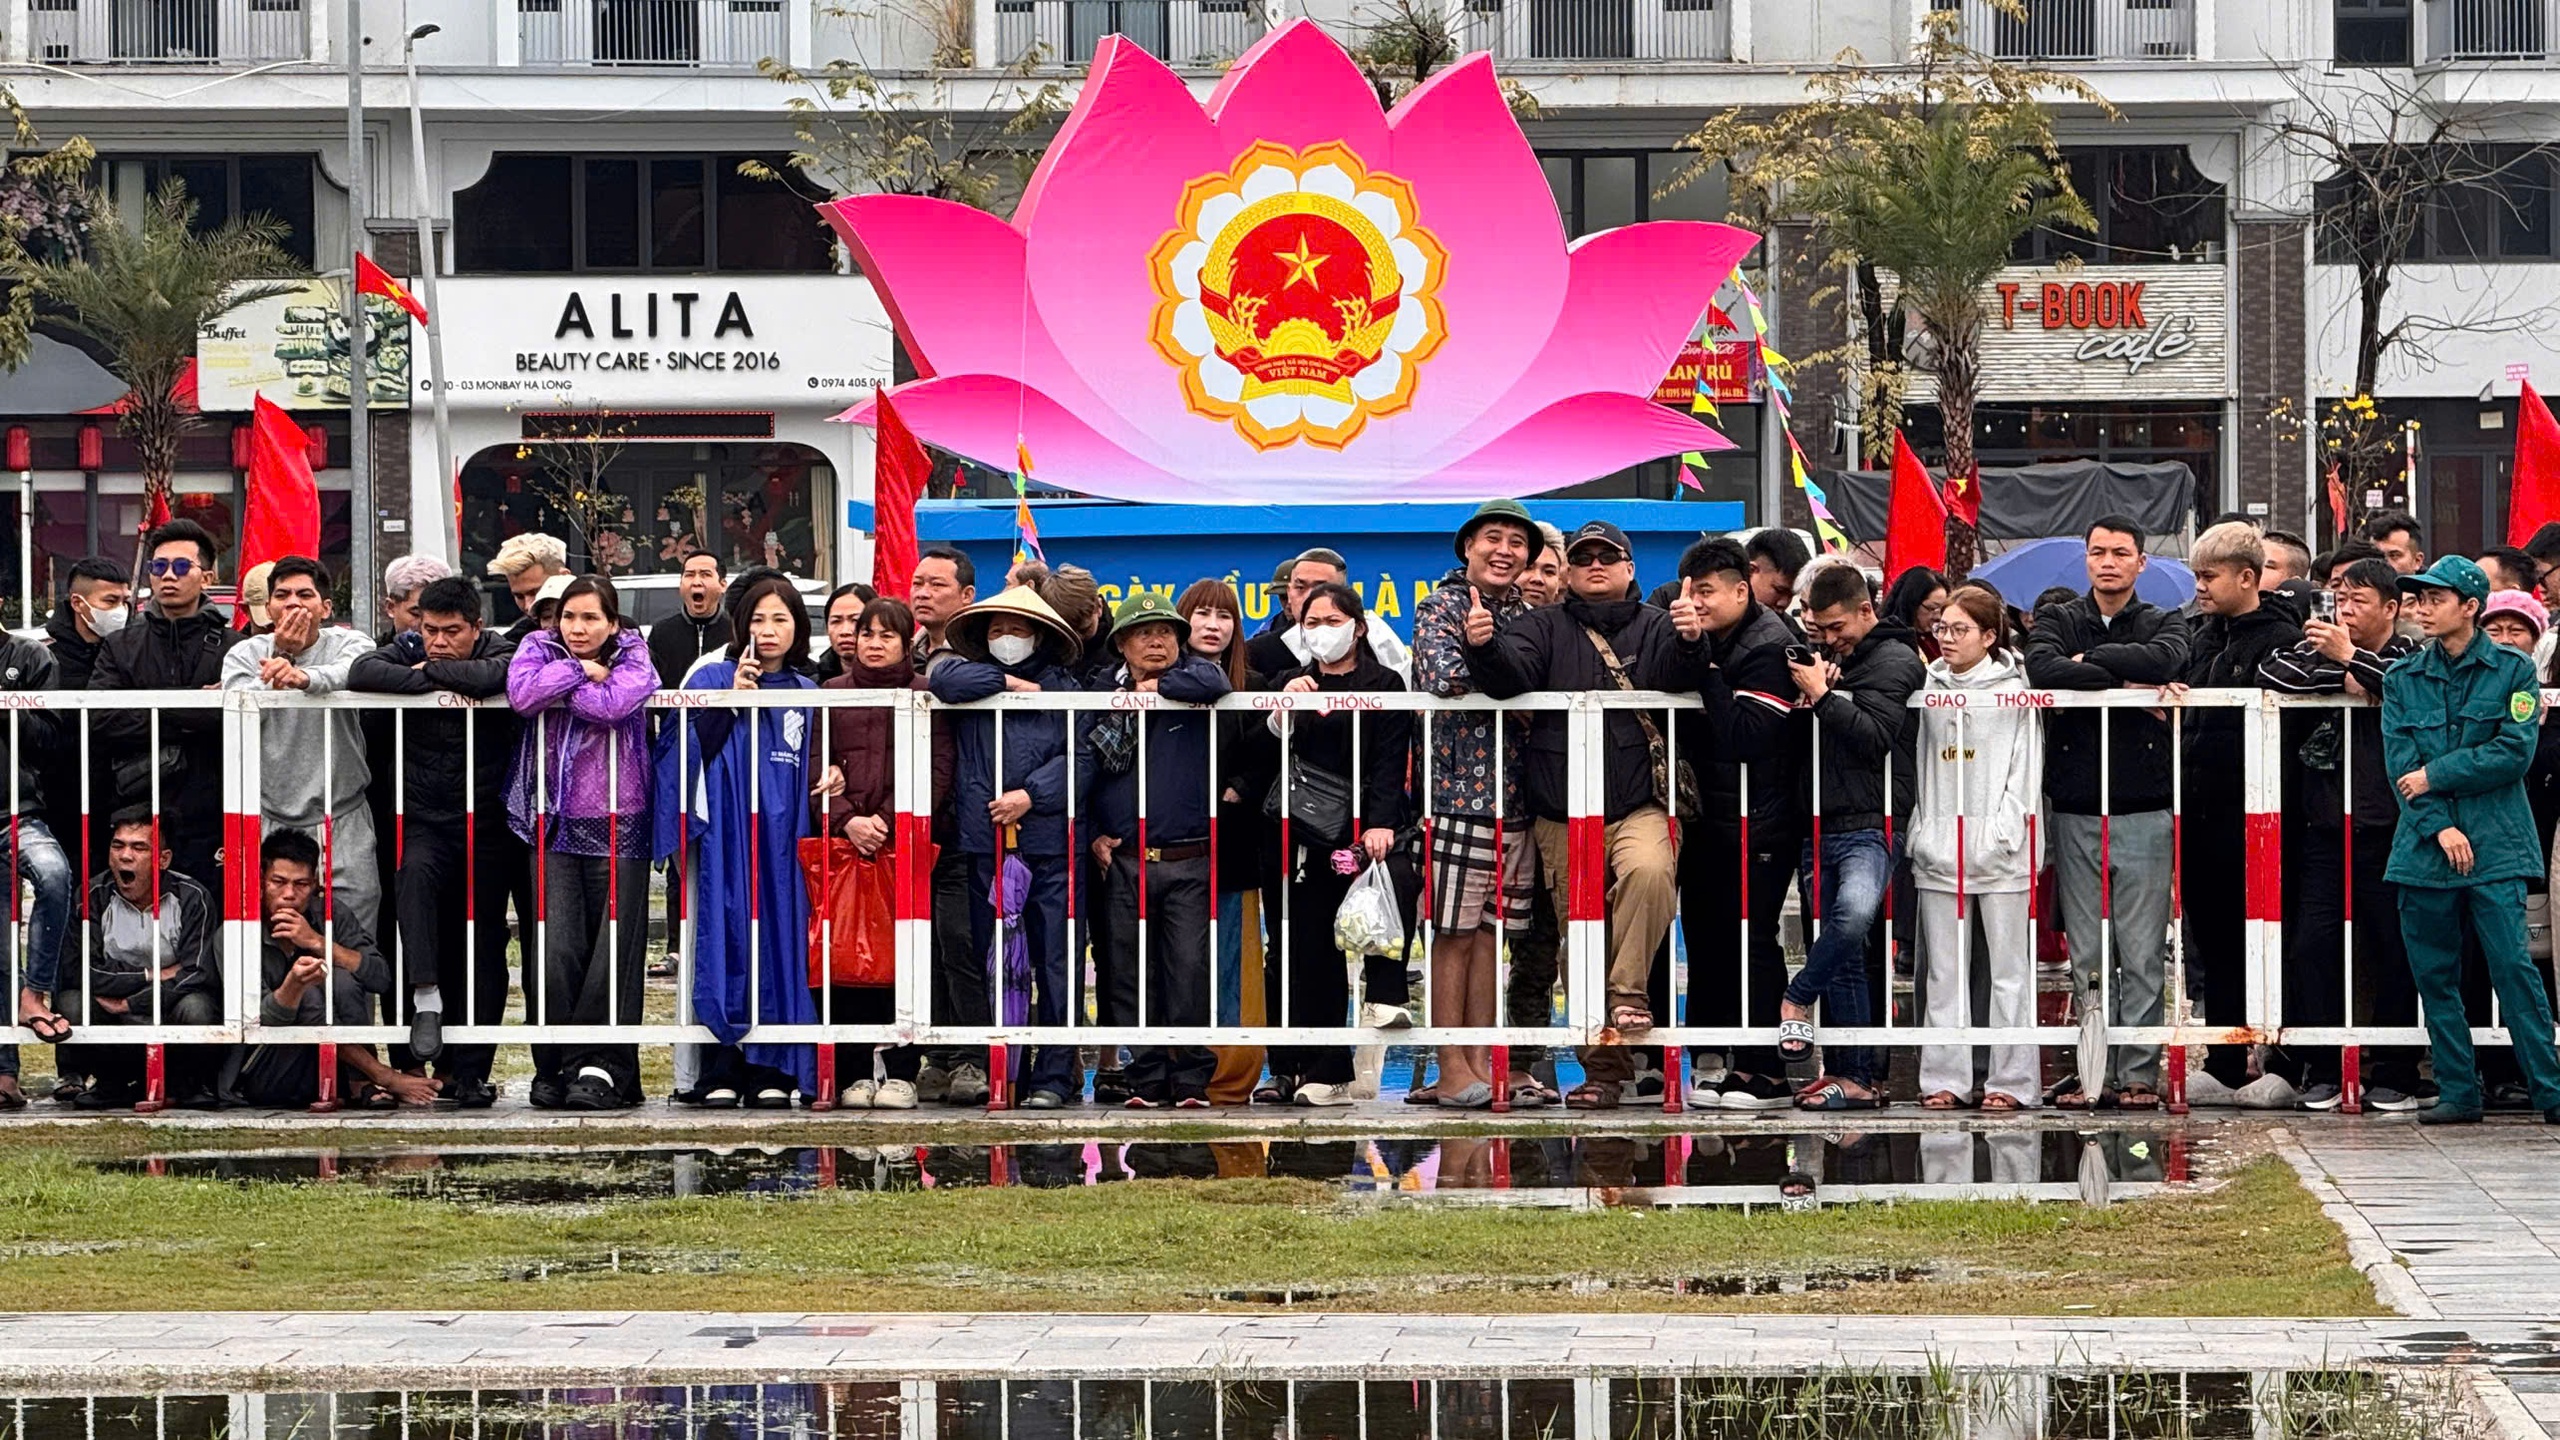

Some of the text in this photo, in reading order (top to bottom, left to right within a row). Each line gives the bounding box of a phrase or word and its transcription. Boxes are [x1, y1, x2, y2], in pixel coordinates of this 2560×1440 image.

[1996, 282, 2147, 330] T-BOOK
[554, 291, 754, 338] ALITA
[203, 324, 246, 341] Buffet
[516, 351, 780, 371] BEAUTY CARE SINCE 2016
[1300, 367, 1328, 379] NAM
[461, 381, 474, 390] 03
[476, 381, 521, 390] MONBAY
[542, 380, 572, 390] LONG
[821, 378, 845, 388] 0974
[848, 378, 867, 387] 405
[652, 692, 709, 706] THÔNG
[1252, 694, 1383, 708] GIAO THÔNG
[1925, 691, 2055, 707] GIAO THÔNG
[1942, 746, 1975, 761] drw
[1780, 1023, 1813, 1038] D&G
